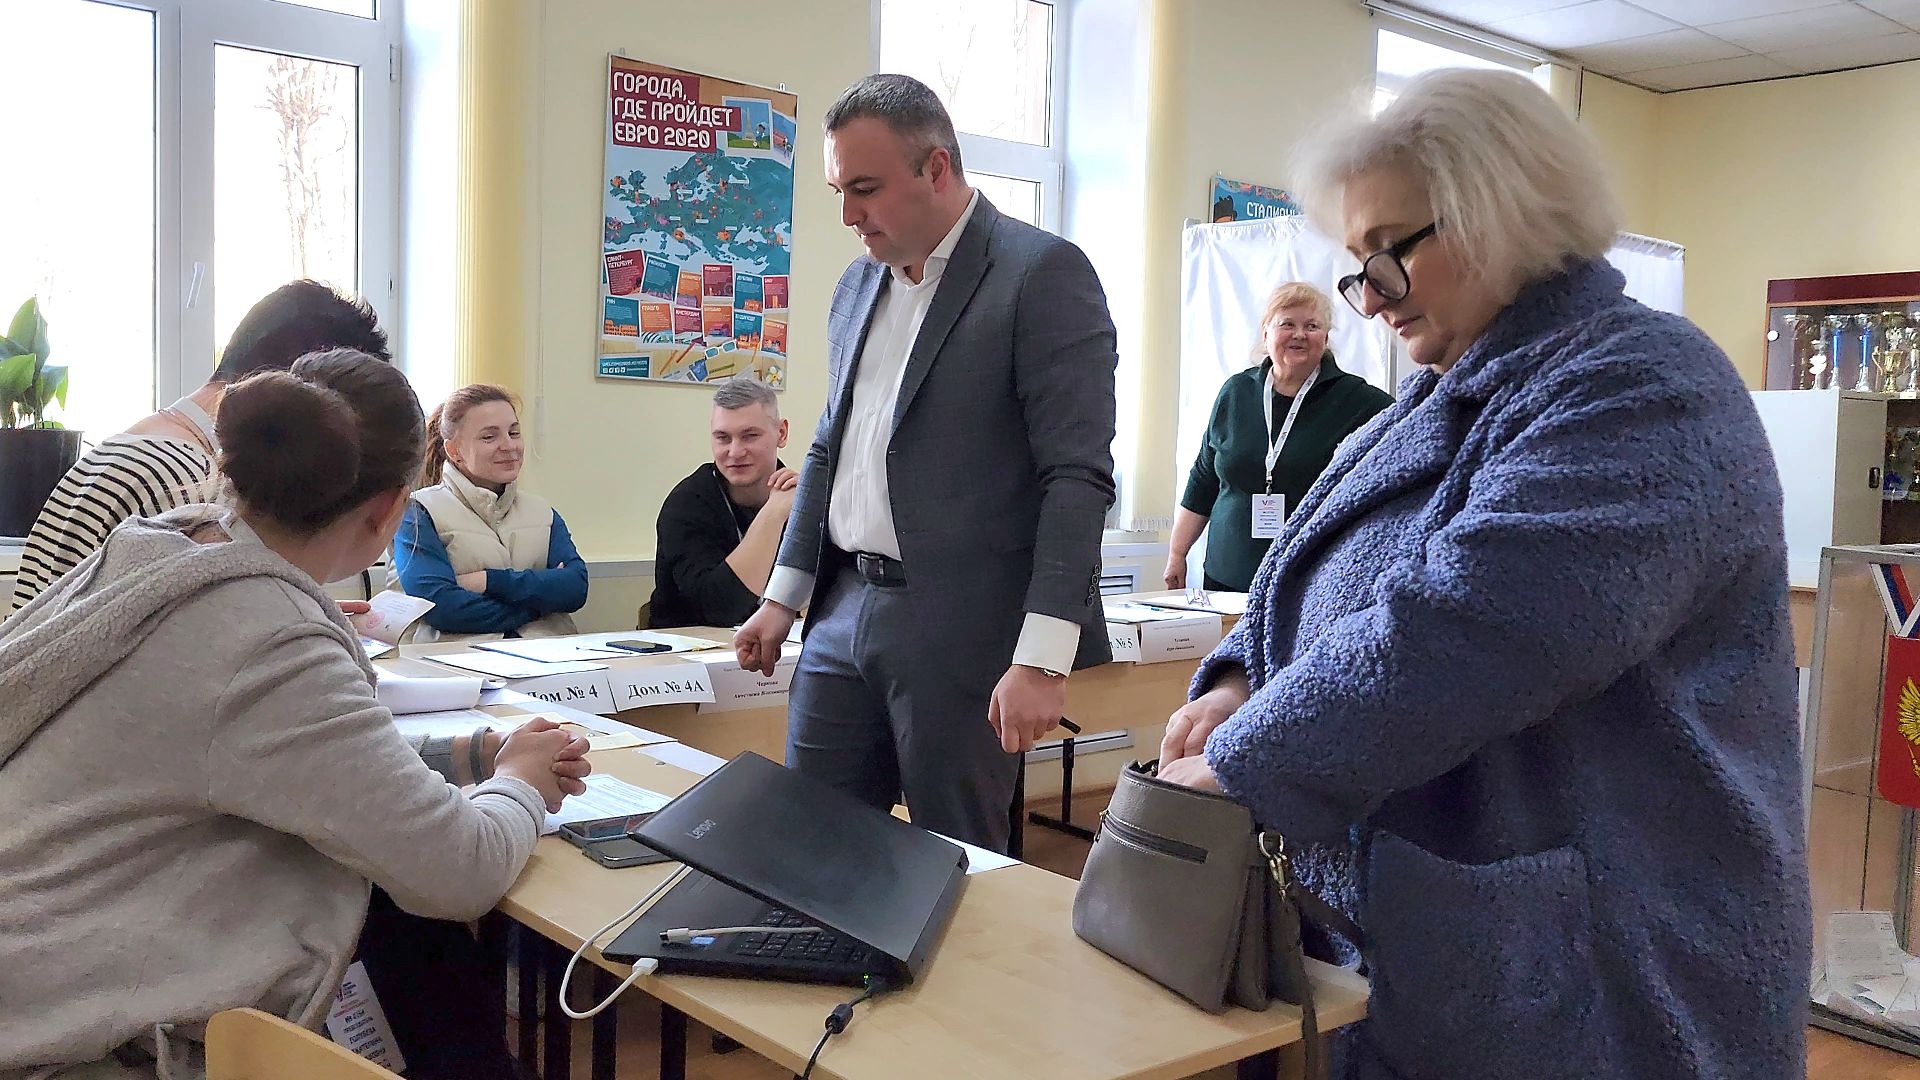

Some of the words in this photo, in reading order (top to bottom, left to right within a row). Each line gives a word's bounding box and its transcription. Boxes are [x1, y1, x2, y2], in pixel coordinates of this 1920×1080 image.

[613, 72, 687, 101] ГОРОДА,
[614, 97, 648, 121] ГДЕ
[651, 100, 733, 128] ПРОЙДЕТ
[615, 122, 659, 144] ЕВРО
[664, 127, 710, 149] 2020
[1127, 637, 1132, 649] 5
[566, 685, 585, 701] №
[589, 684, 598, 698] 4
[628, 684, 661, 700] Дом
[664, 681, 681, 694] №
